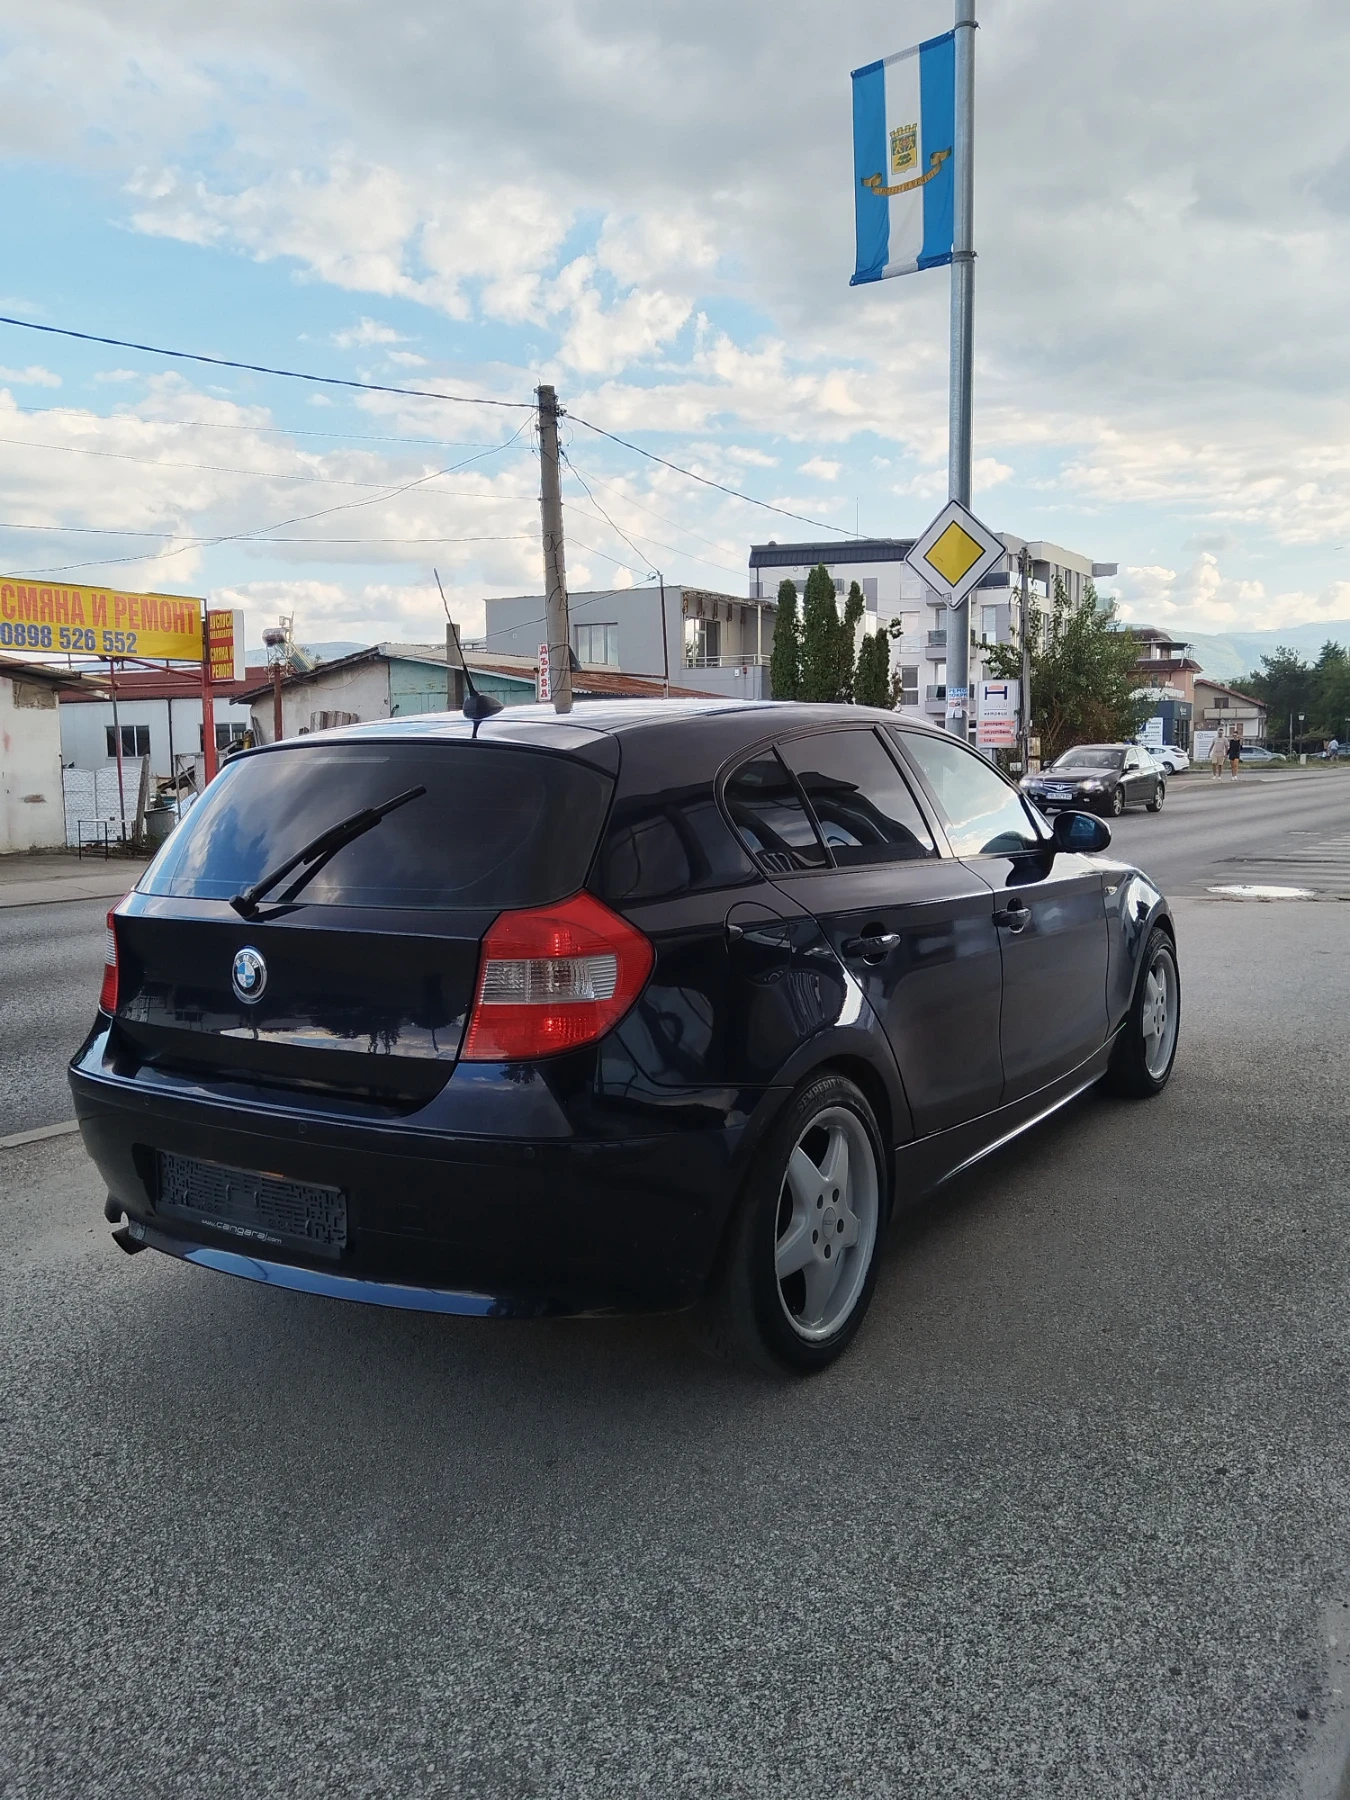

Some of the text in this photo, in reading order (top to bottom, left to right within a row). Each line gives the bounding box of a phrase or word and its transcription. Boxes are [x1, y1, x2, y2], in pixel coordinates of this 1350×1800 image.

[0, 583, 196, 635] СМЯНА И РЕМОНТ
[0, 622, 138, 654] 0898 526 552
[211, 662, 233, 680] РЕМОНТ
[540, 645, 549, 698] ДЪРВА
[235, 954, 260, 969] BMW
[796, 1078, 837, 1114] SEMPERIT
